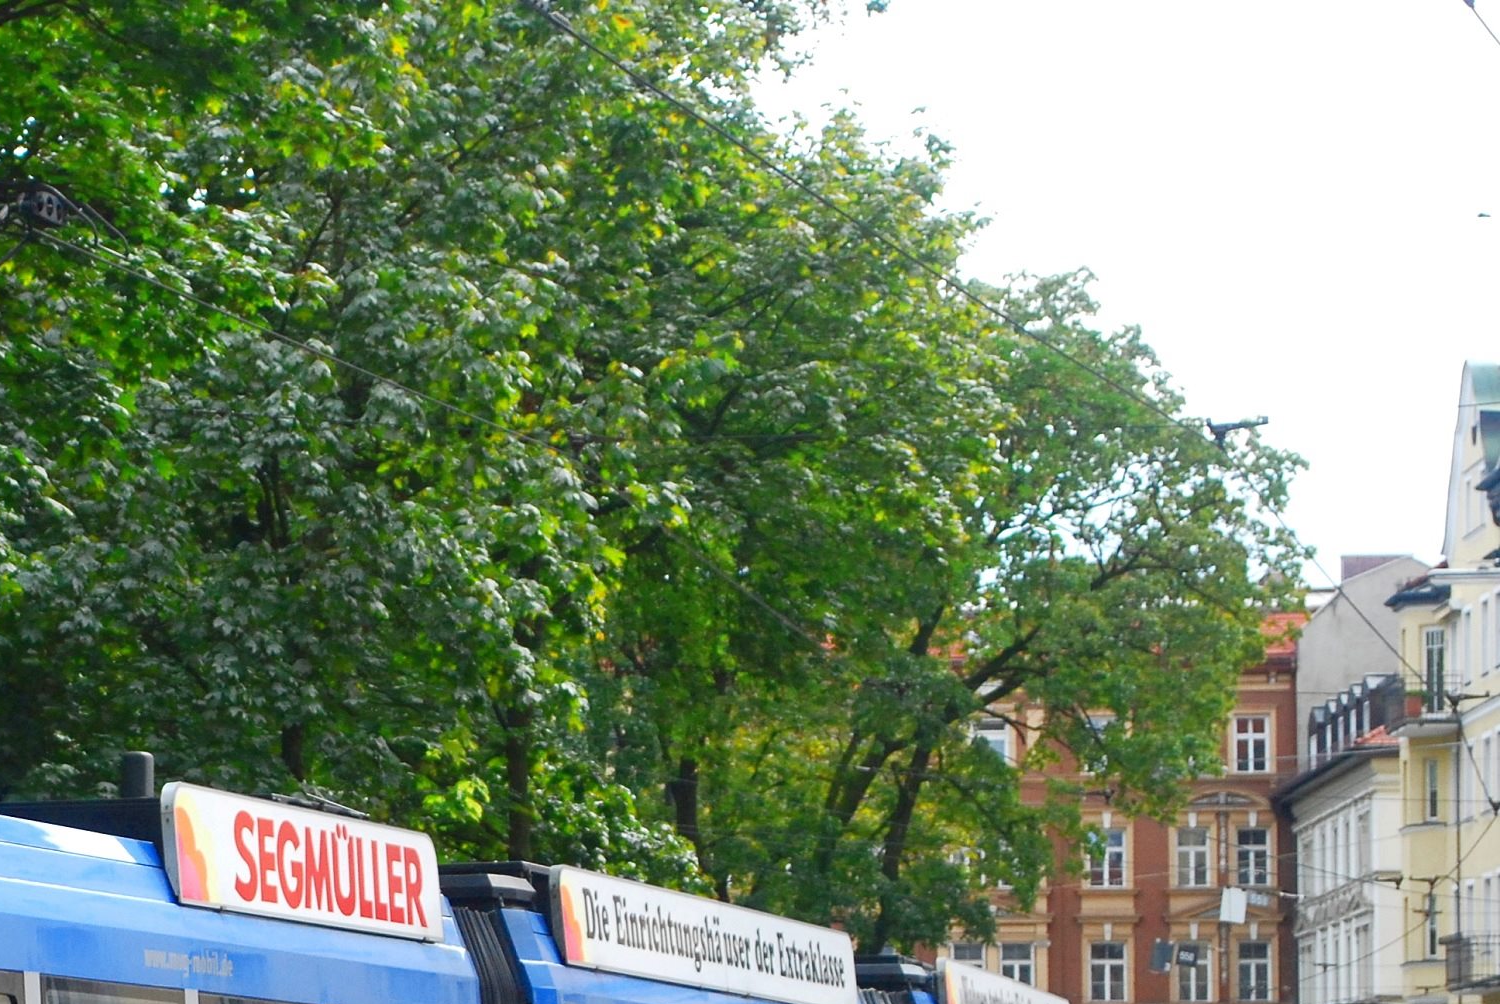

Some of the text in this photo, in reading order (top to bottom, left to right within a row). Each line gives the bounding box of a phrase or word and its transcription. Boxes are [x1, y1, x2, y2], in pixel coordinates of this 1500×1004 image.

[234, 810, 428, 928] SEGMÜLLER
[582, 887, 846, 988] Die Einrichtungshäuser der Extraklasse
